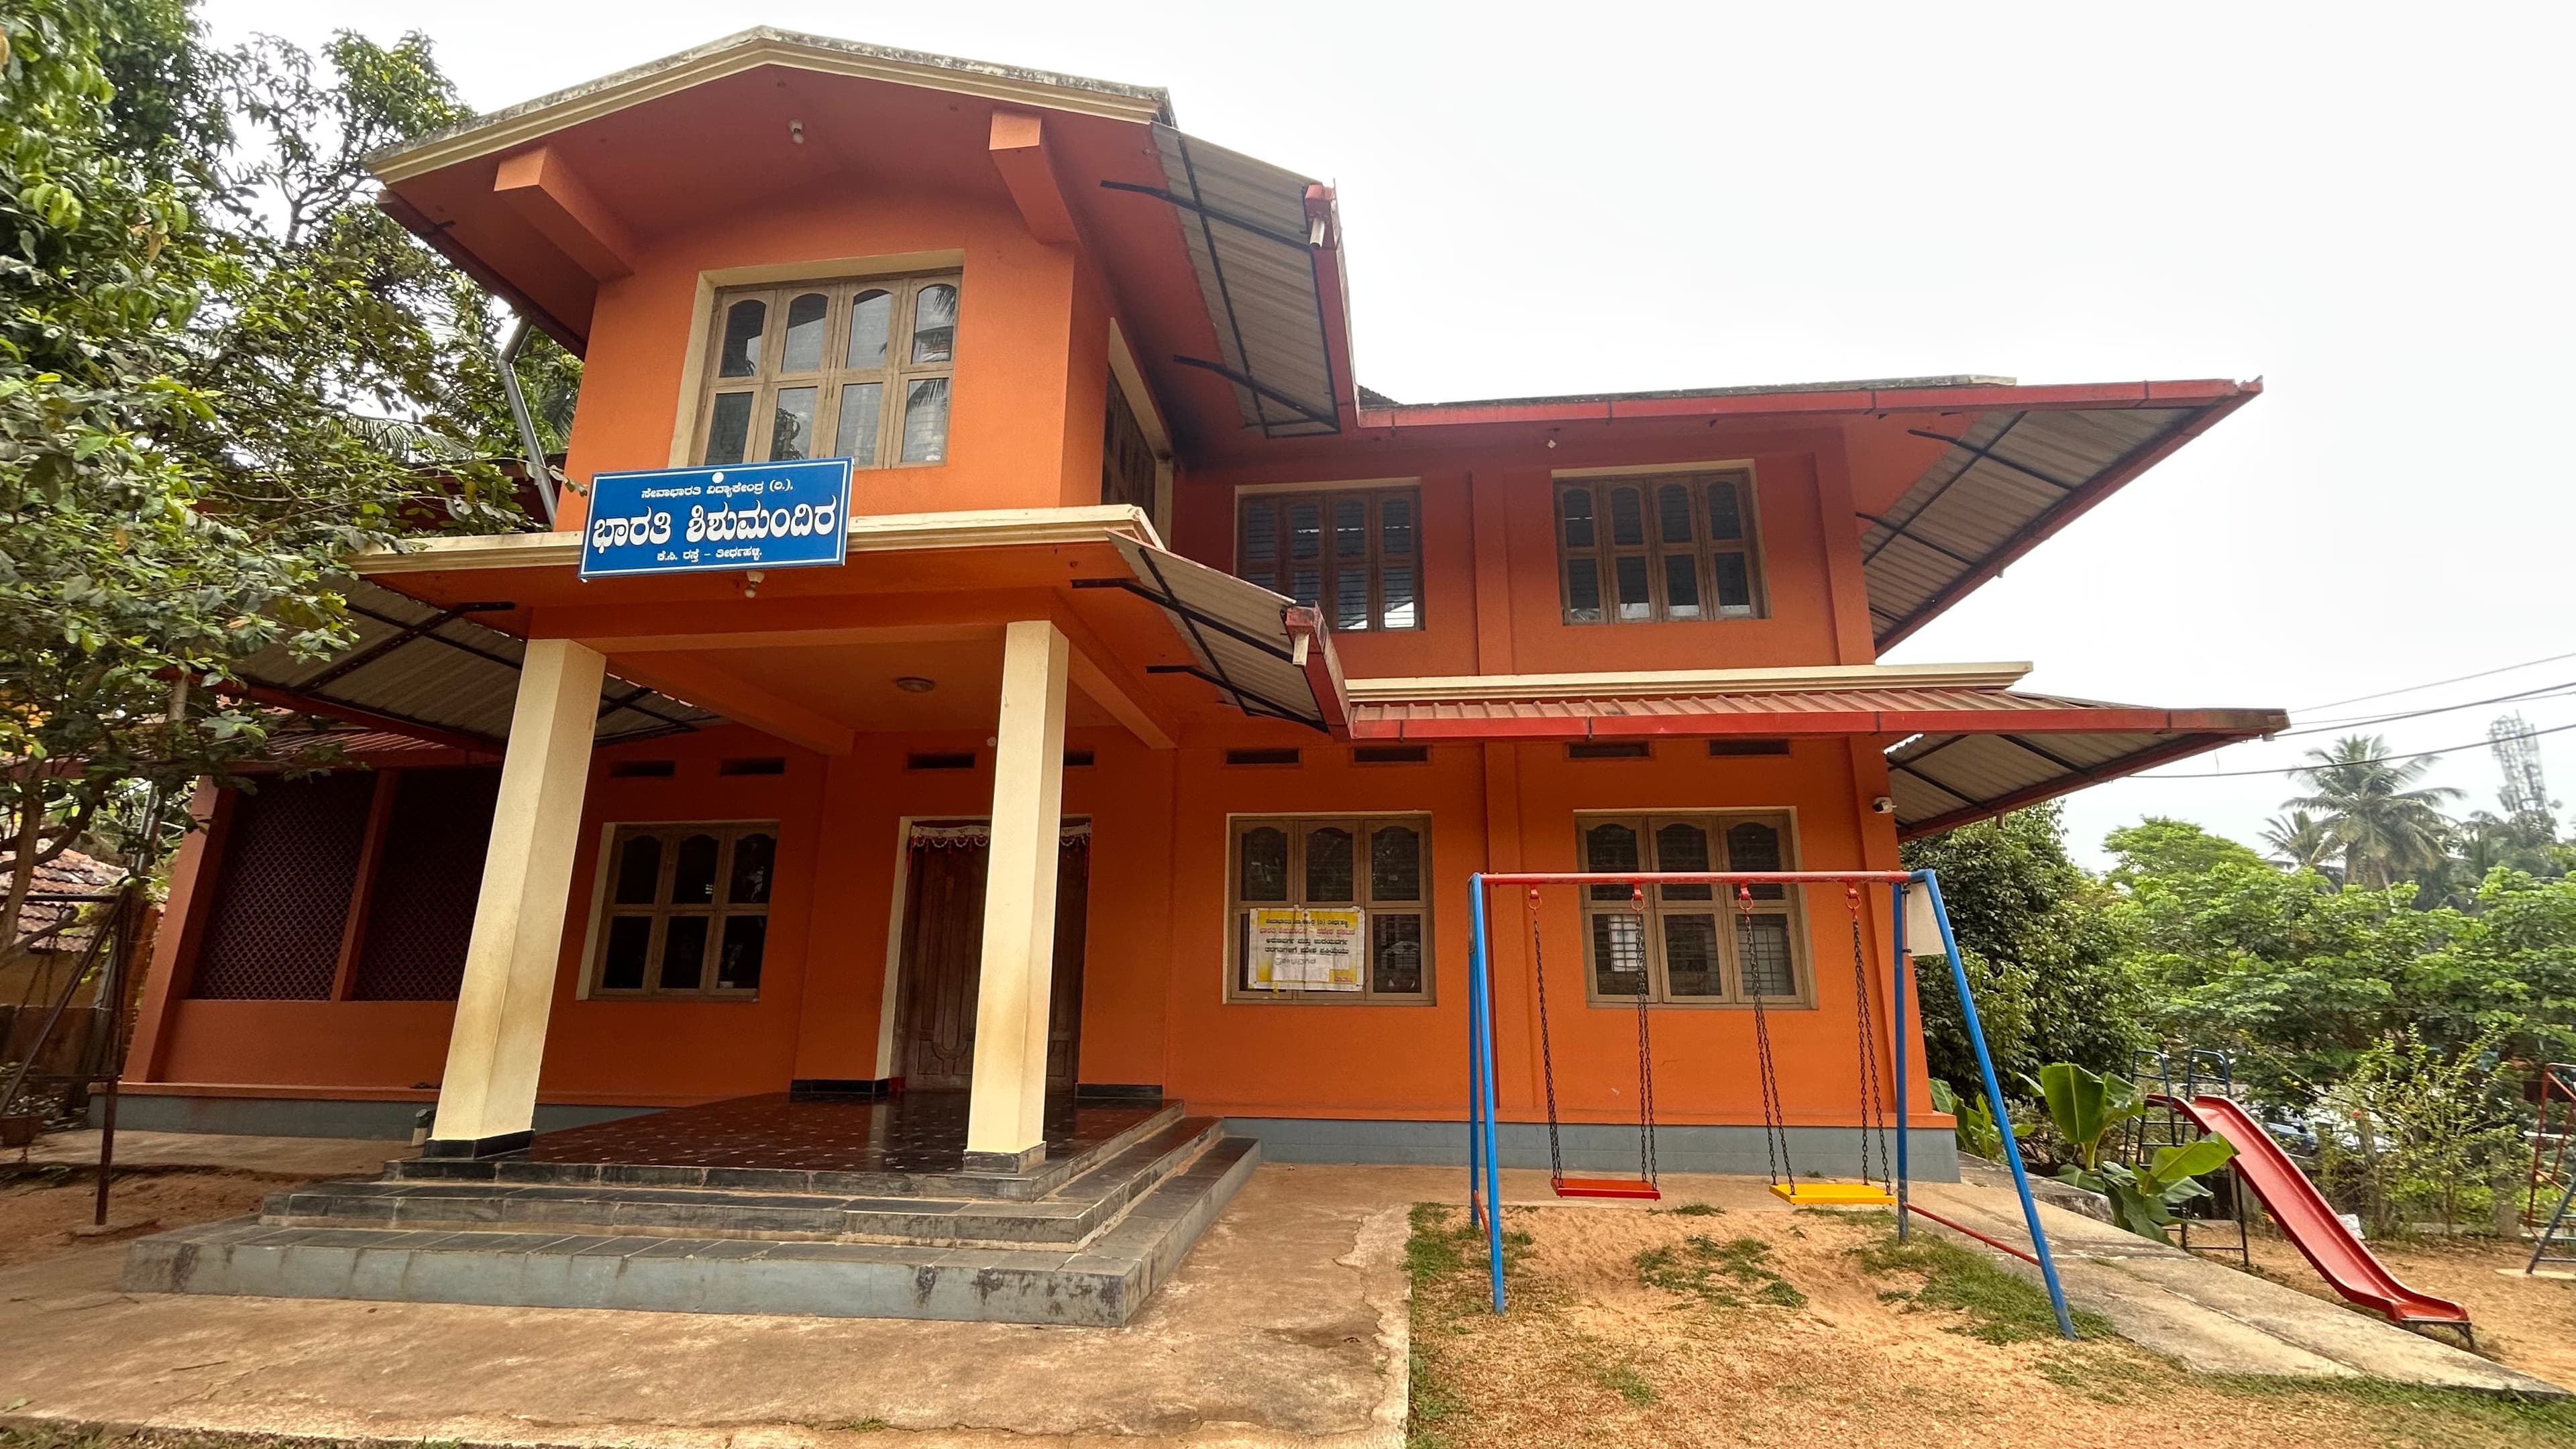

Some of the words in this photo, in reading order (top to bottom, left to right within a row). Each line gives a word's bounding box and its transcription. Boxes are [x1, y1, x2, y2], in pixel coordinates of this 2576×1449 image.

[641, 486, 702, 498] ಸೇವಾಭಾರತಿ
[706, 482, 764, 498] ವಿದ್ಯಾಕೇಂದ್ರ
[592, 506, 672, 553] ಭಾರತಿ
[686, 495, 837, 543] ಶಿಶುಮಂದಿರ
[682, 548, 700, 563] ರಸ್ತೆ
